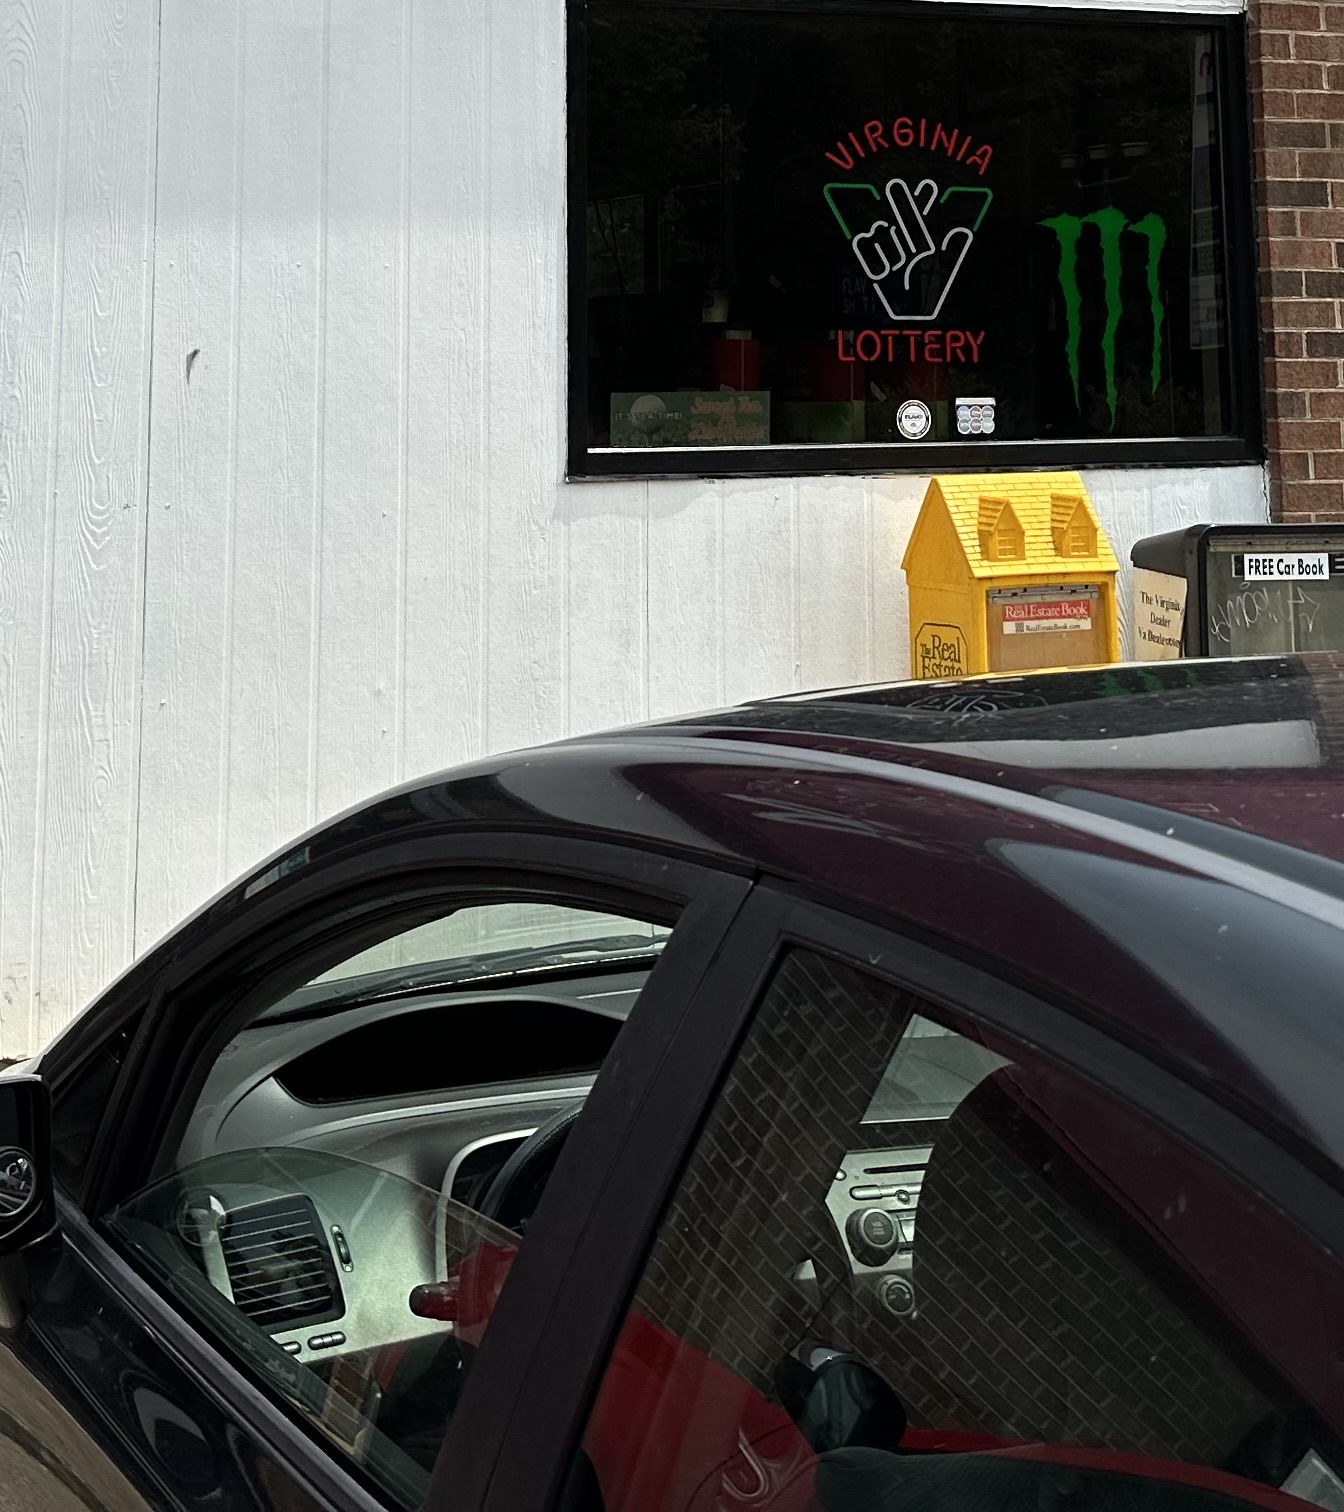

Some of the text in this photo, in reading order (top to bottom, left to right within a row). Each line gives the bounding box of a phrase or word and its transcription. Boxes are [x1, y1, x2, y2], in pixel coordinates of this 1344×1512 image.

[824, 116, 993, 176] VIRGINIA
[836, 329, 986, 363] LOTTERY
[1248, 559, 1274, 576] FREE
[1276, 559, 1295, 576] Car
[1298, 558, 1324, 576] Book
[1004, 601, 1088, 619] Real Estate Book
[1140, 591, 1154, 606] The
[931, 634, 962, 664] Real
